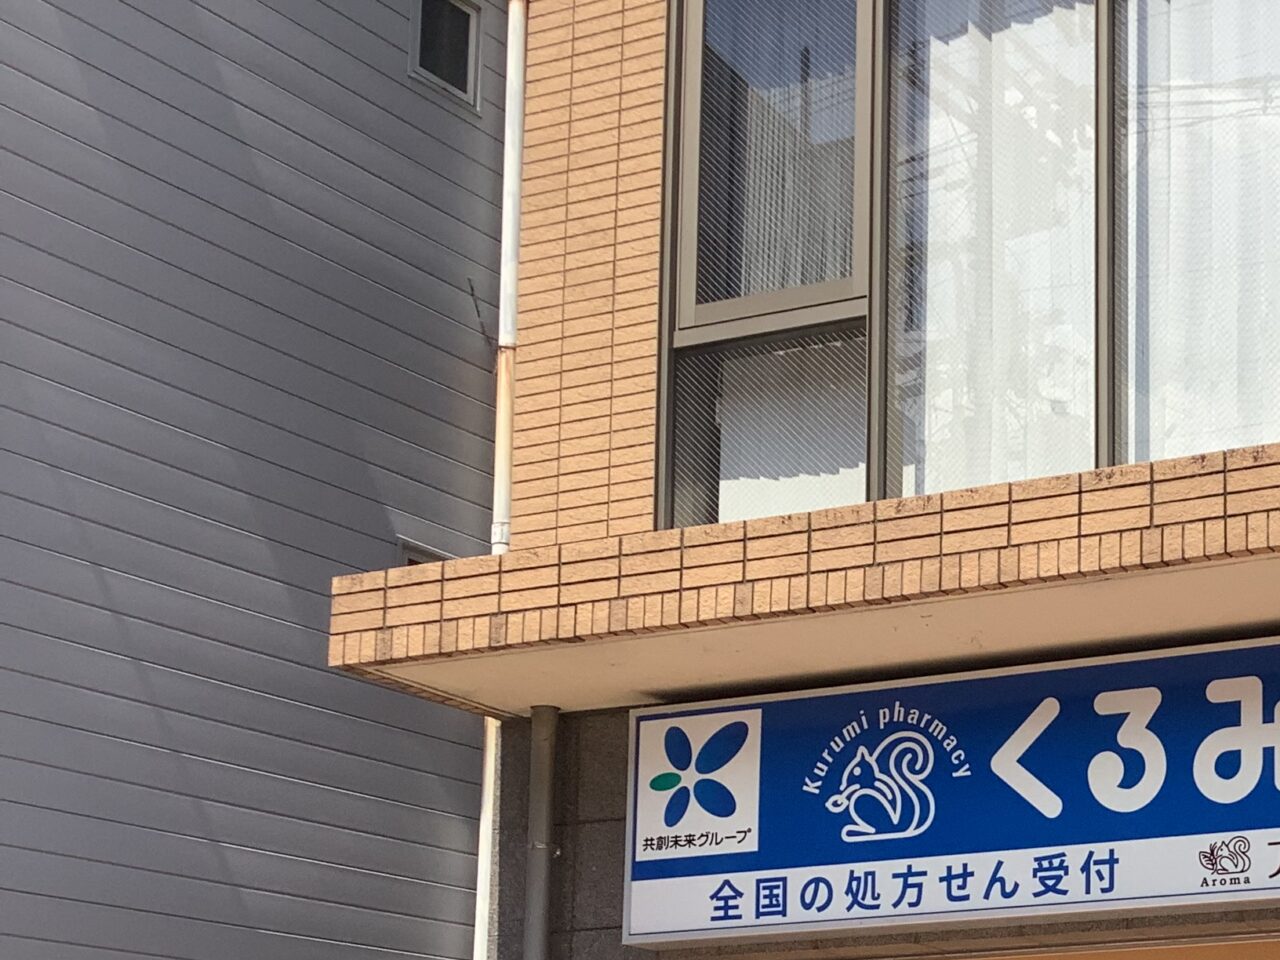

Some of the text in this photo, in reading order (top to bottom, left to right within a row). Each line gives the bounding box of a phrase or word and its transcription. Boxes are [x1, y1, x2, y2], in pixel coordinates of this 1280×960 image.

[802, 701, 972, 796] Kurumi pharmacy
[642, 827, 753, 852] 共創未来グループ
[709, 848, 1120, 922] 全国の処方せん受付
[1200, 875, 1251, 888] Aroma
